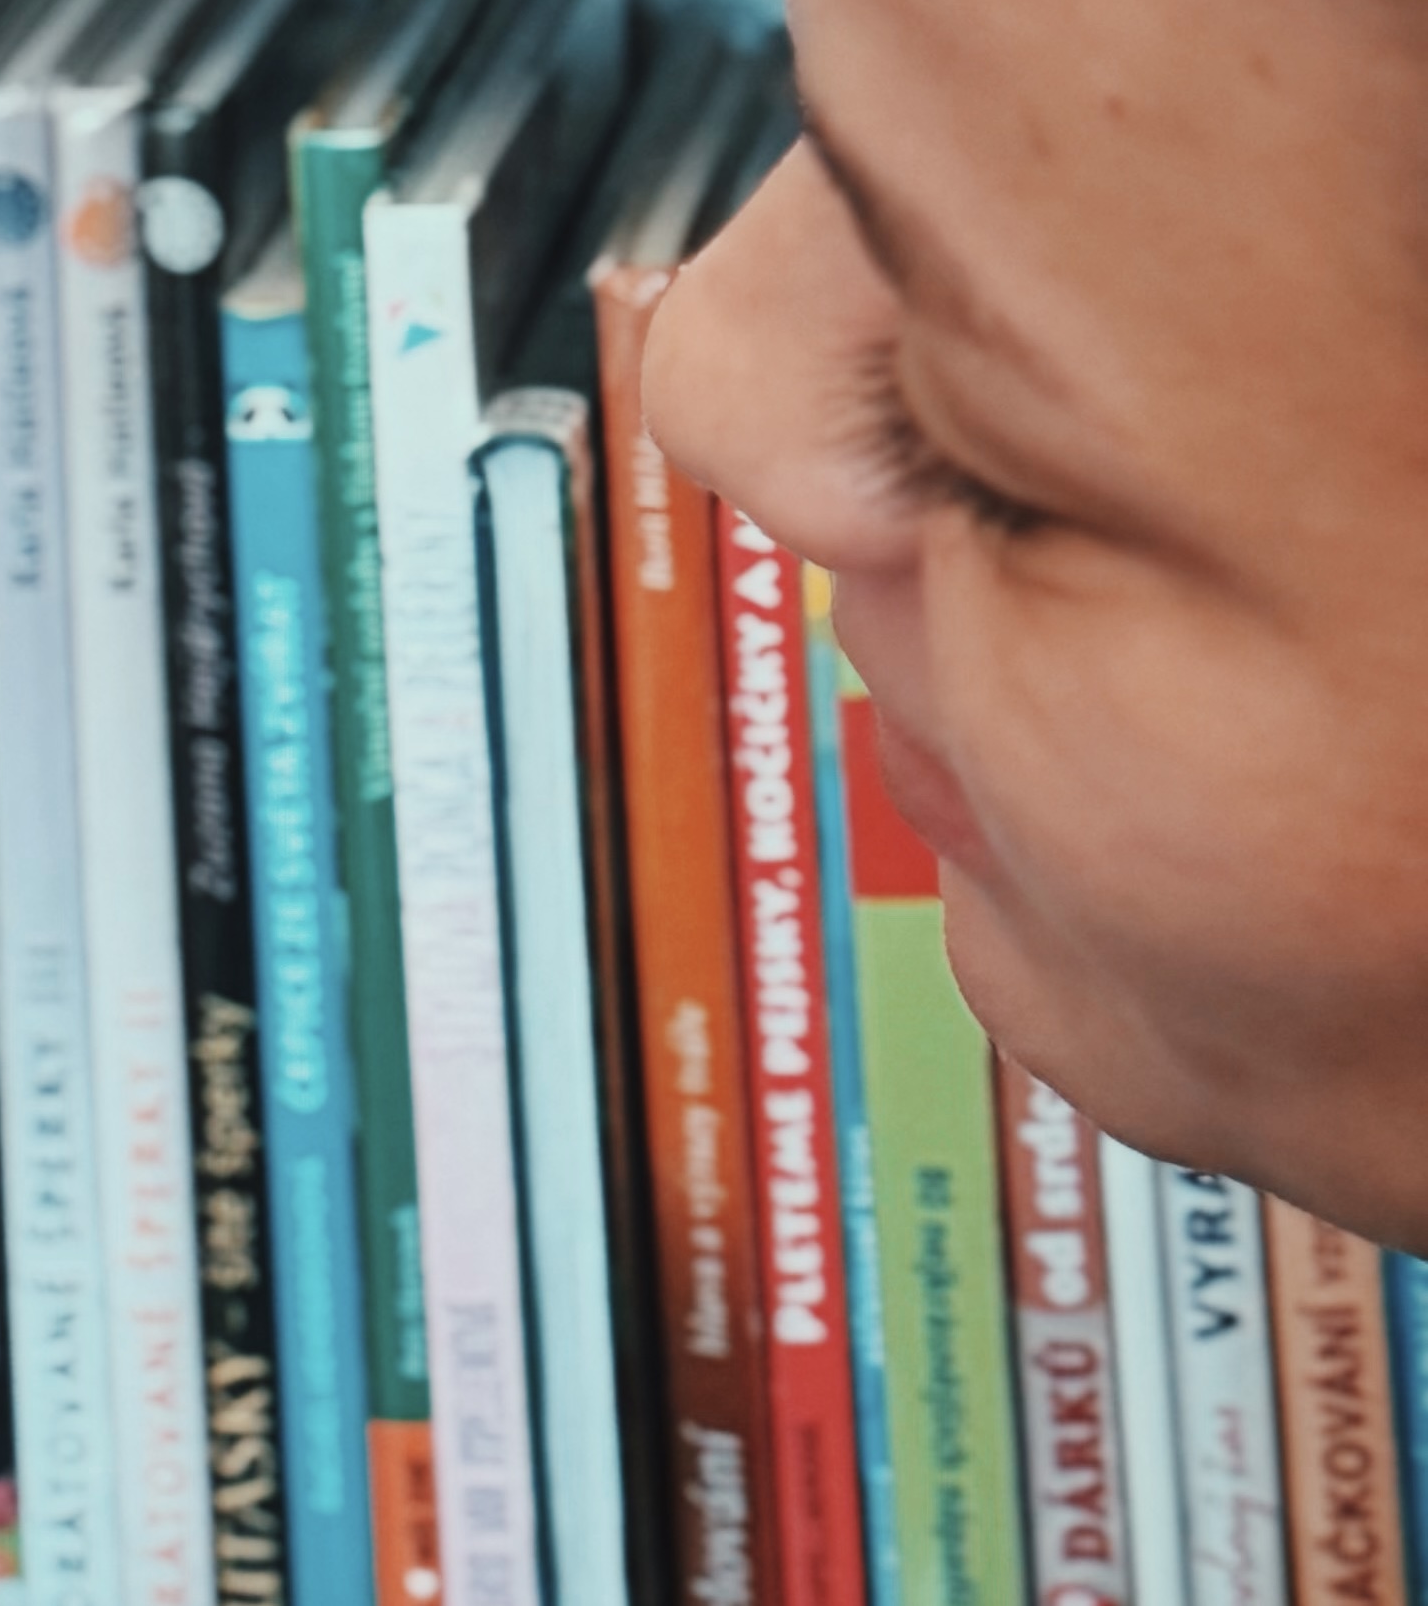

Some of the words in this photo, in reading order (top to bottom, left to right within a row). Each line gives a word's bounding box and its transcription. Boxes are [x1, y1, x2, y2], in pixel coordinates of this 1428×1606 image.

[732, 558, 784, 610] A
[730, 611, 801, 863] KOČIČKY
[762, 1089, 828, 1345] PLETEME
[1017, 1079, 1079, 1218] srdc
[1024, 1231, 1089, 1307] od
[1027, 1339, 1113, 1563] DÁRKŮ
